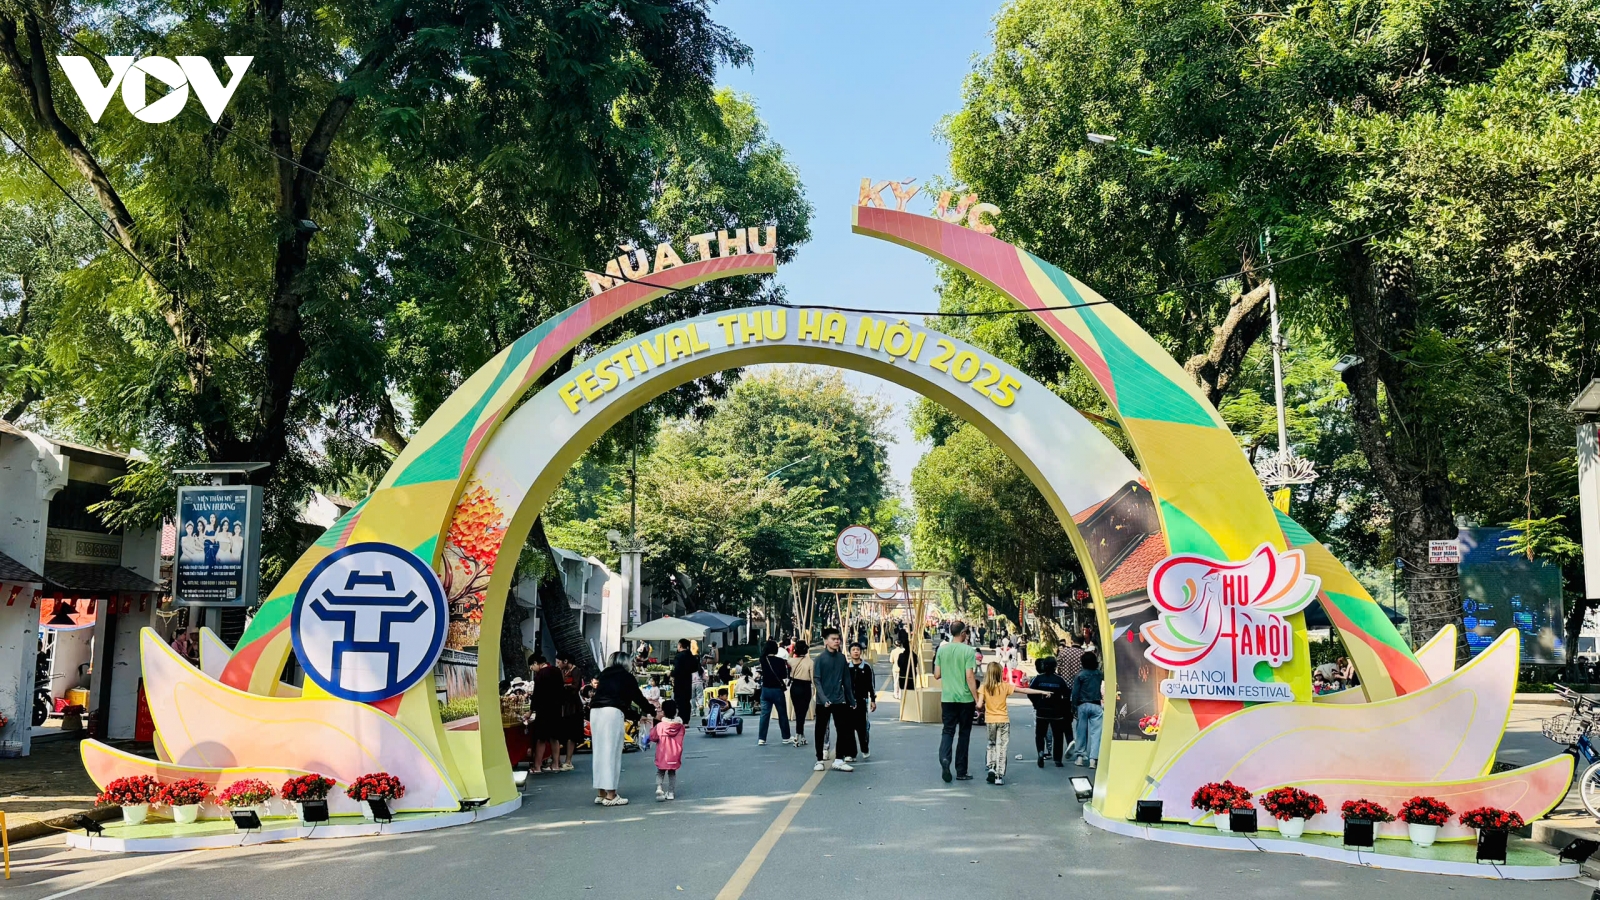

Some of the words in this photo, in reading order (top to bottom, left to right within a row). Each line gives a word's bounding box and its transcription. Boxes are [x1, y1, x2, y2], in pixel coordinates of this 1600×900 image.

[858, 177, 922, 211] KÝ
[936, 184, 1001, 234] ỨC
[583, 243, 684, 296] MÙA
[690, 226, 777, 261] THU
[558, 323, 710, 414] FESTIVAL
[717, 309, 787, 346] THU
[856, 316, 926, 363] NỘI
[929, 338, 1022, 407] 2025
[1179, 669, 1226, 683] HANOI
[1180, 683, 1235, 696] AUTUMN
[1238, 685, 1290, 698] FESTIVAL
